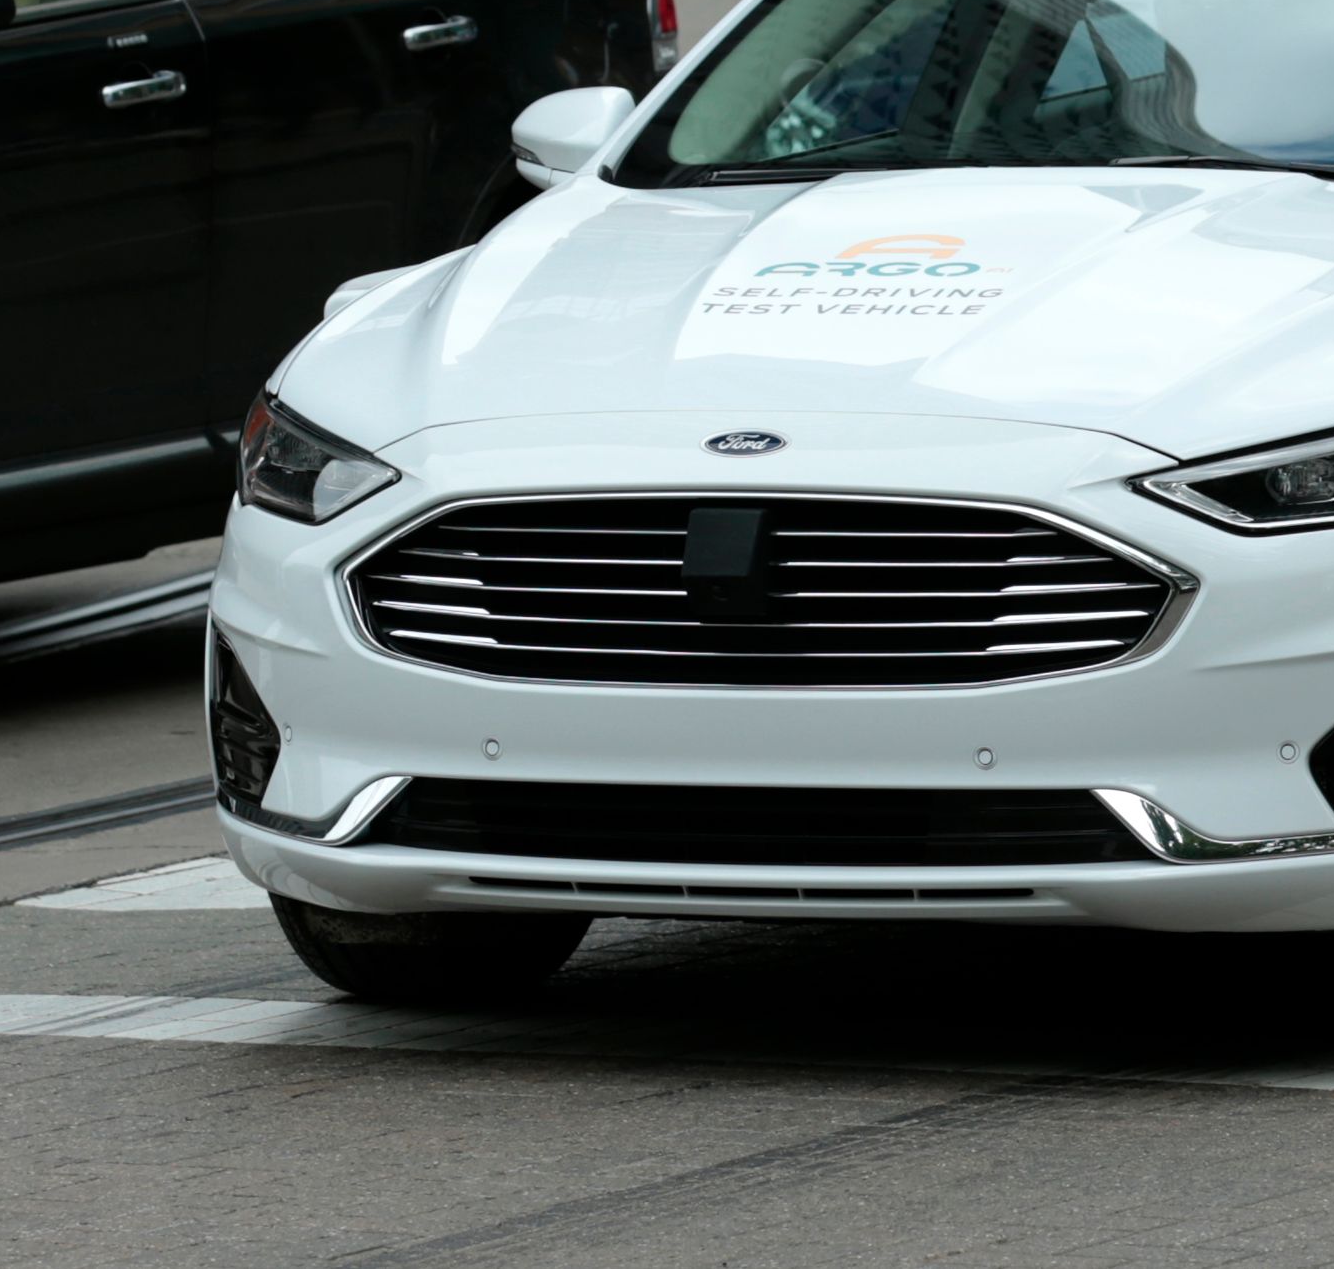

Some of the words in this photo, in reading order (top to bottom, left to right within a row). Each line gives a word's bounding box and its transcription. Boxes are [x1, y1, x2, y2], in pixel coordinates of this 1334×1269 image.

[753, 261, 981, 278] ARGO
[712, 286, 1005, 299] SELF-DRIVING
[701, 302, 802, 315] TEST
[817, 303, 987, 316] VEHICLE
[717, 433, 771, 450] Ford
